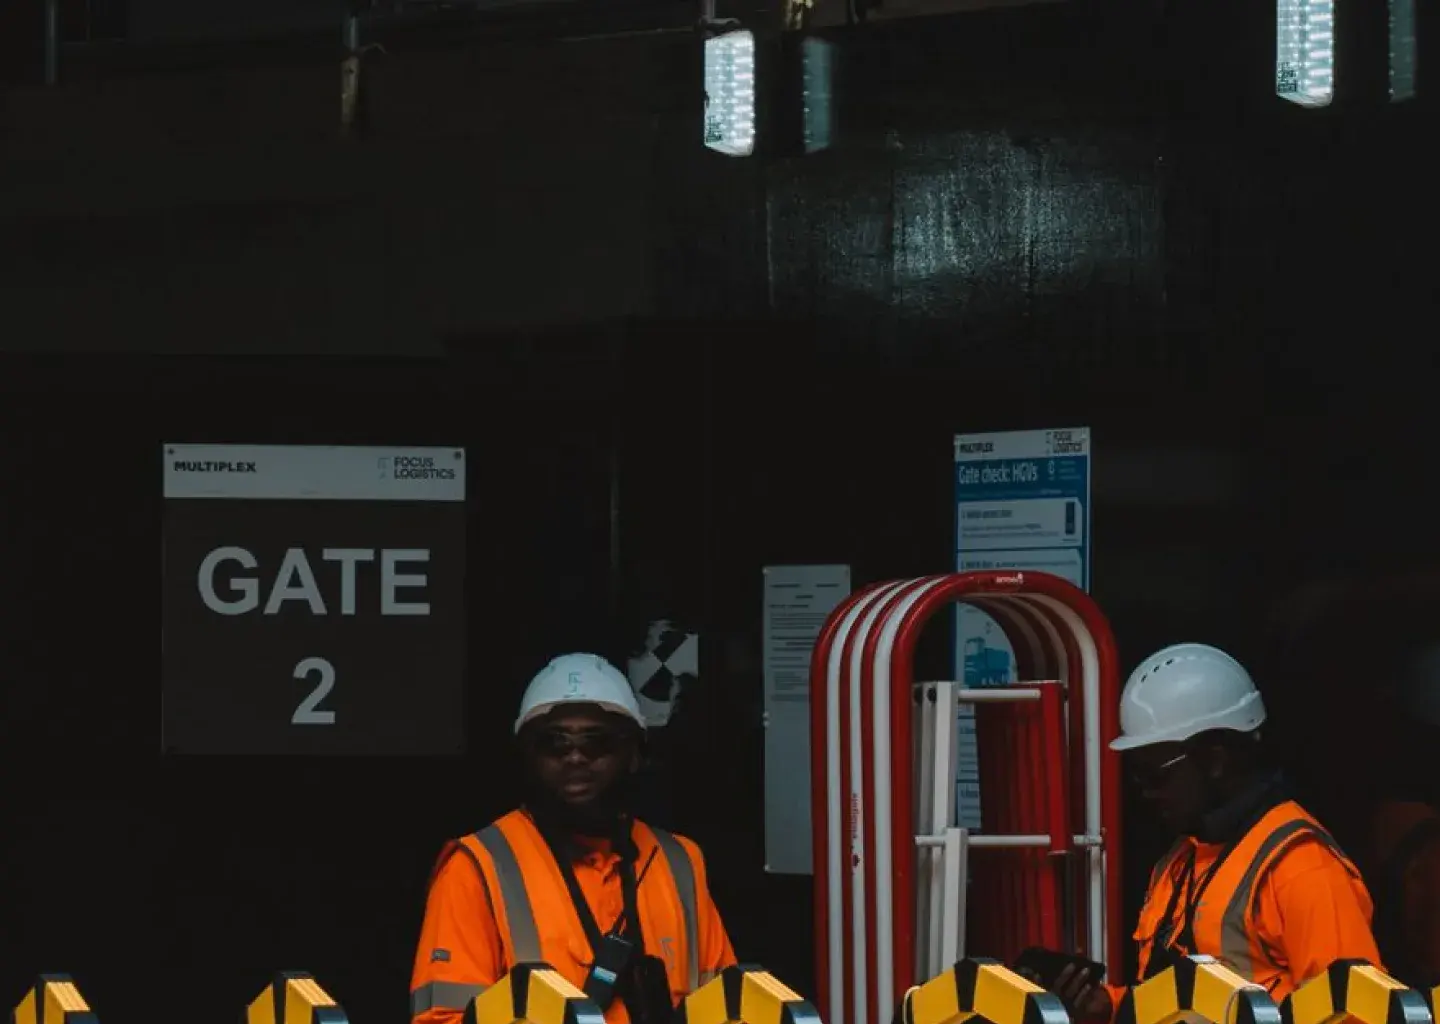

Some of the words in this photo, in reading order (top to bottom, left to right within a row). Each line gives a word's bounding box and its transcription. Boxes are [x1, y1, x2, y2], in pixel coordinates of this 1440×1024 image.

[174, 461, 256, 473] MULTIPLEX
[394, 456, 434, 468] FOCUS
[394, 468, 456, 480] LOGISTICS
[958, 464, 980, 485] Gate
[1012, 461, 1039, 483] HGVs
[197, 545, 431, 616] GATE
[290, 656, 336, 725] 2
